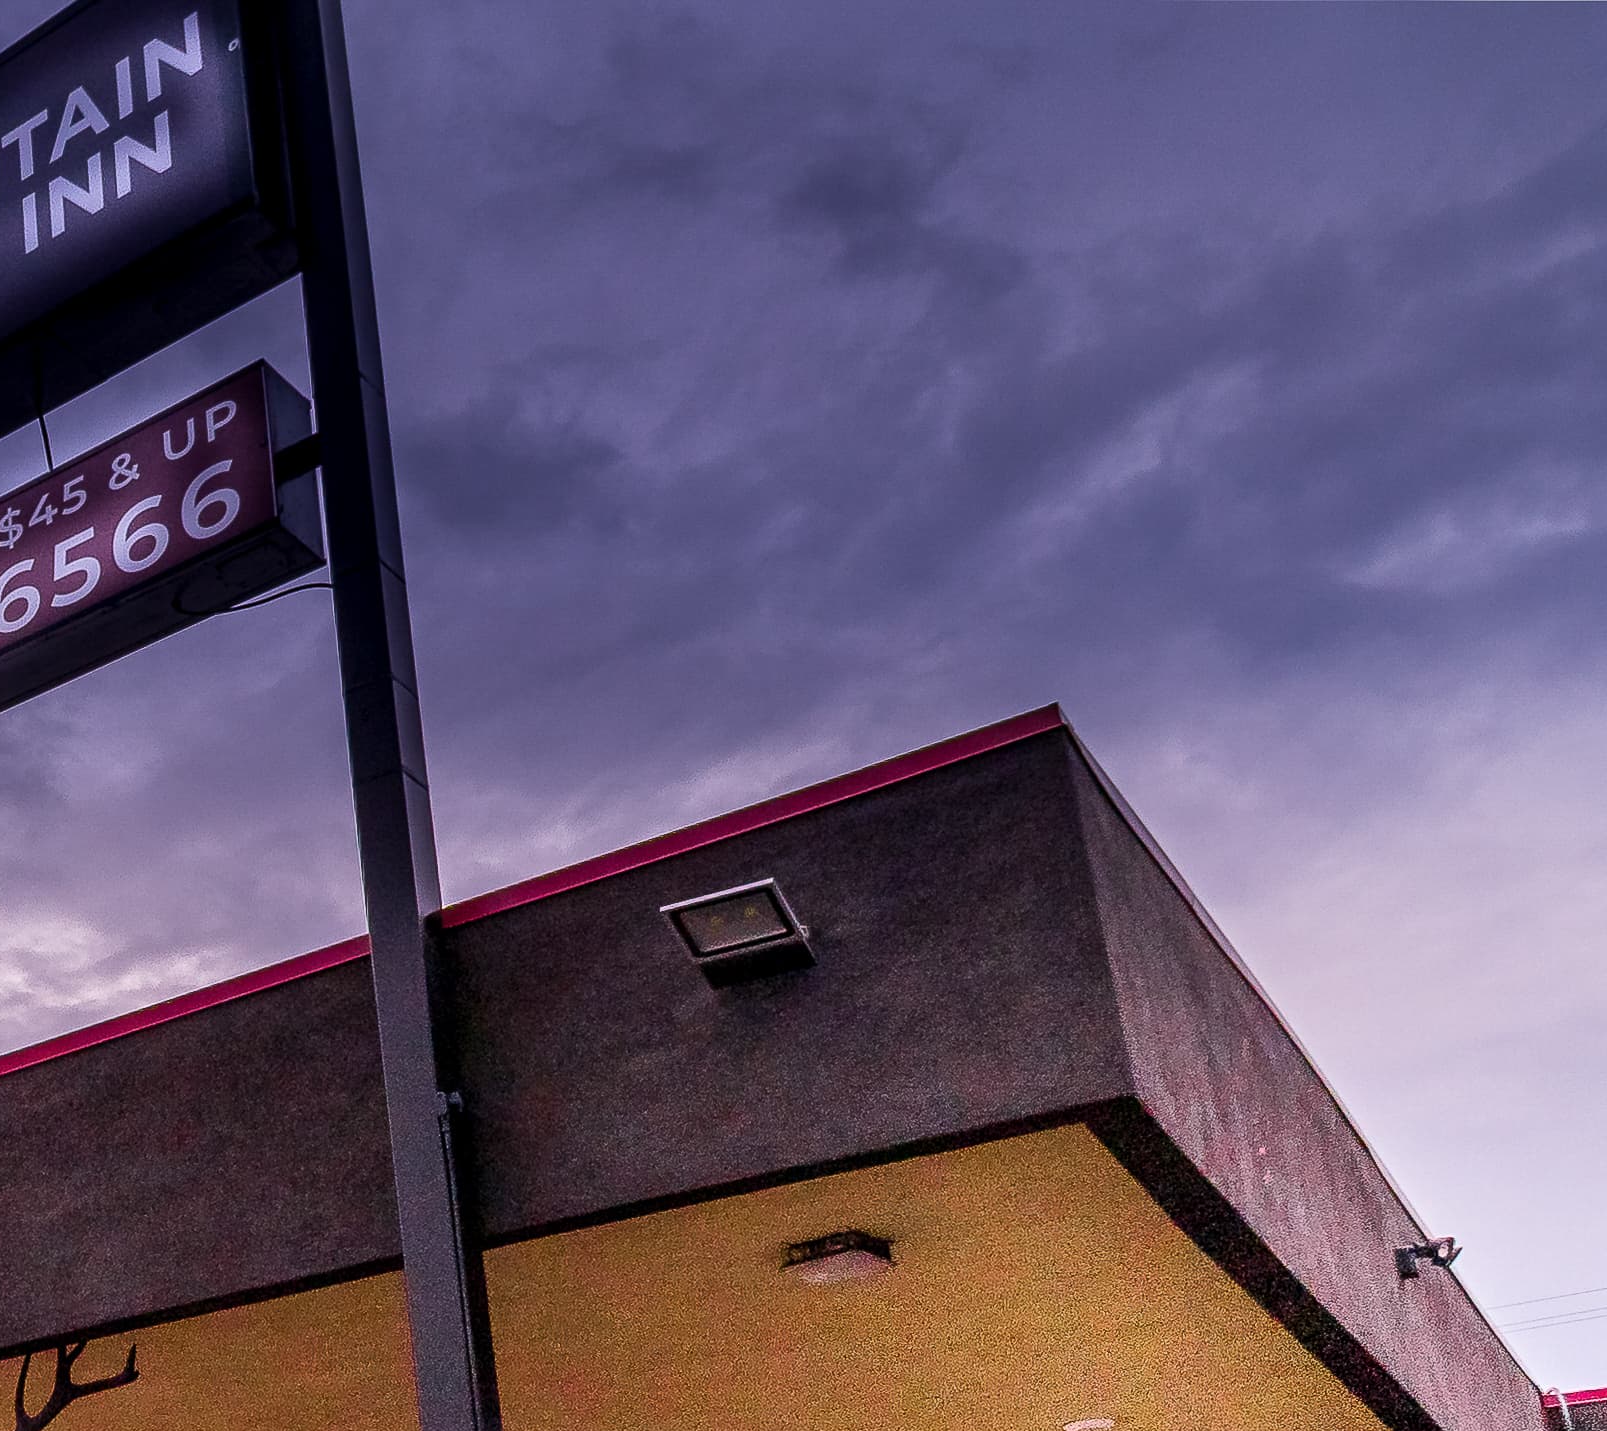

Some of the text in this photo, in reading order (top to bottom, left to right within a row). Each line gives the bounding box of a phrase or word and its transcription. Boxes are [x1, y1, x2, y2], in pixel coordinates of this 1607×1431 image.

[22, 109, 172, 255] INN
[108, 452, 141, 491] &
[162, 400, 238, 461] UP
